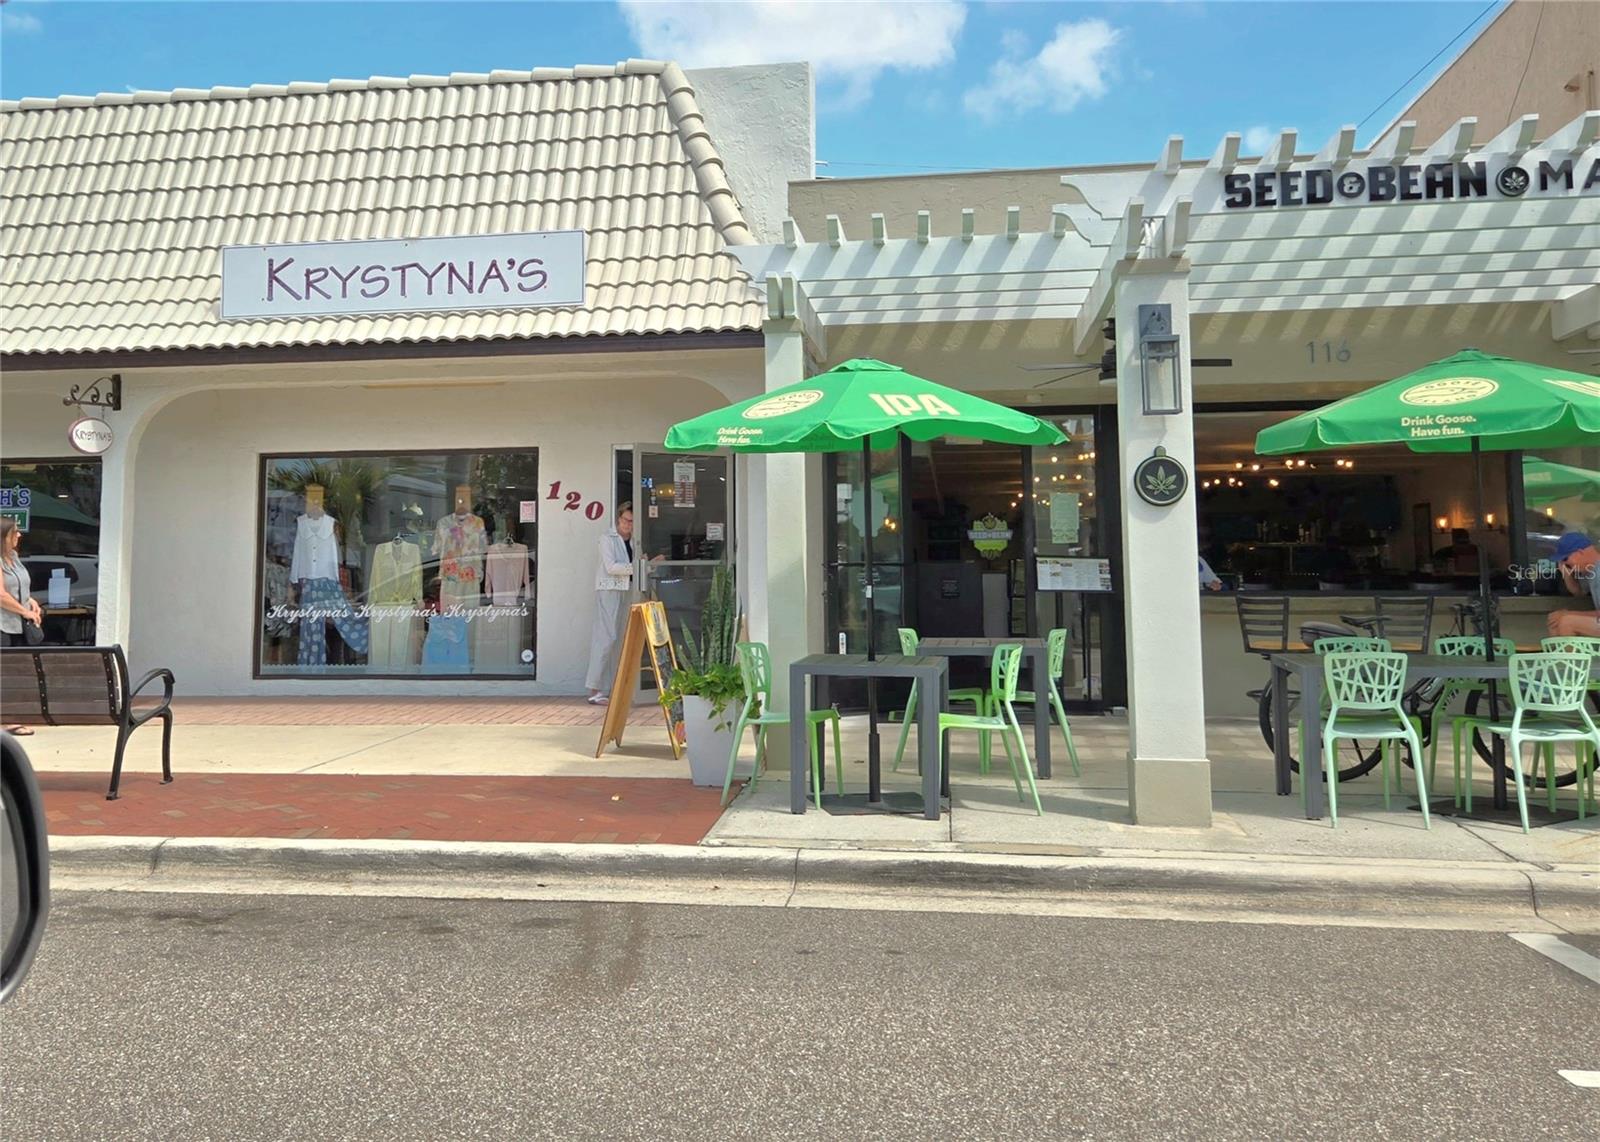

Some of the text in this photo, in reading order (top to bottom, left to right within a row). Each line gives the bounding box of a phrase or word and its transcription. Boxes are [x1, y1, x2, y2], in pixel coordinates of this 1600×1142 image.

[1224, 169, 1333, 208] SEED
[1368, 161, 1487, 202] BEAN
[1305, 340, 1352, 364] 116
[867, 393, 960, 416] IPA
[1401, 414, 1477, 426] Drink Goose.
[1411, 425, 1465, 437] Have fun.
[546, 481, 605, 520] 120
[266, 602, 530, 625] Krystyna's Krystyna's Krystyna's
